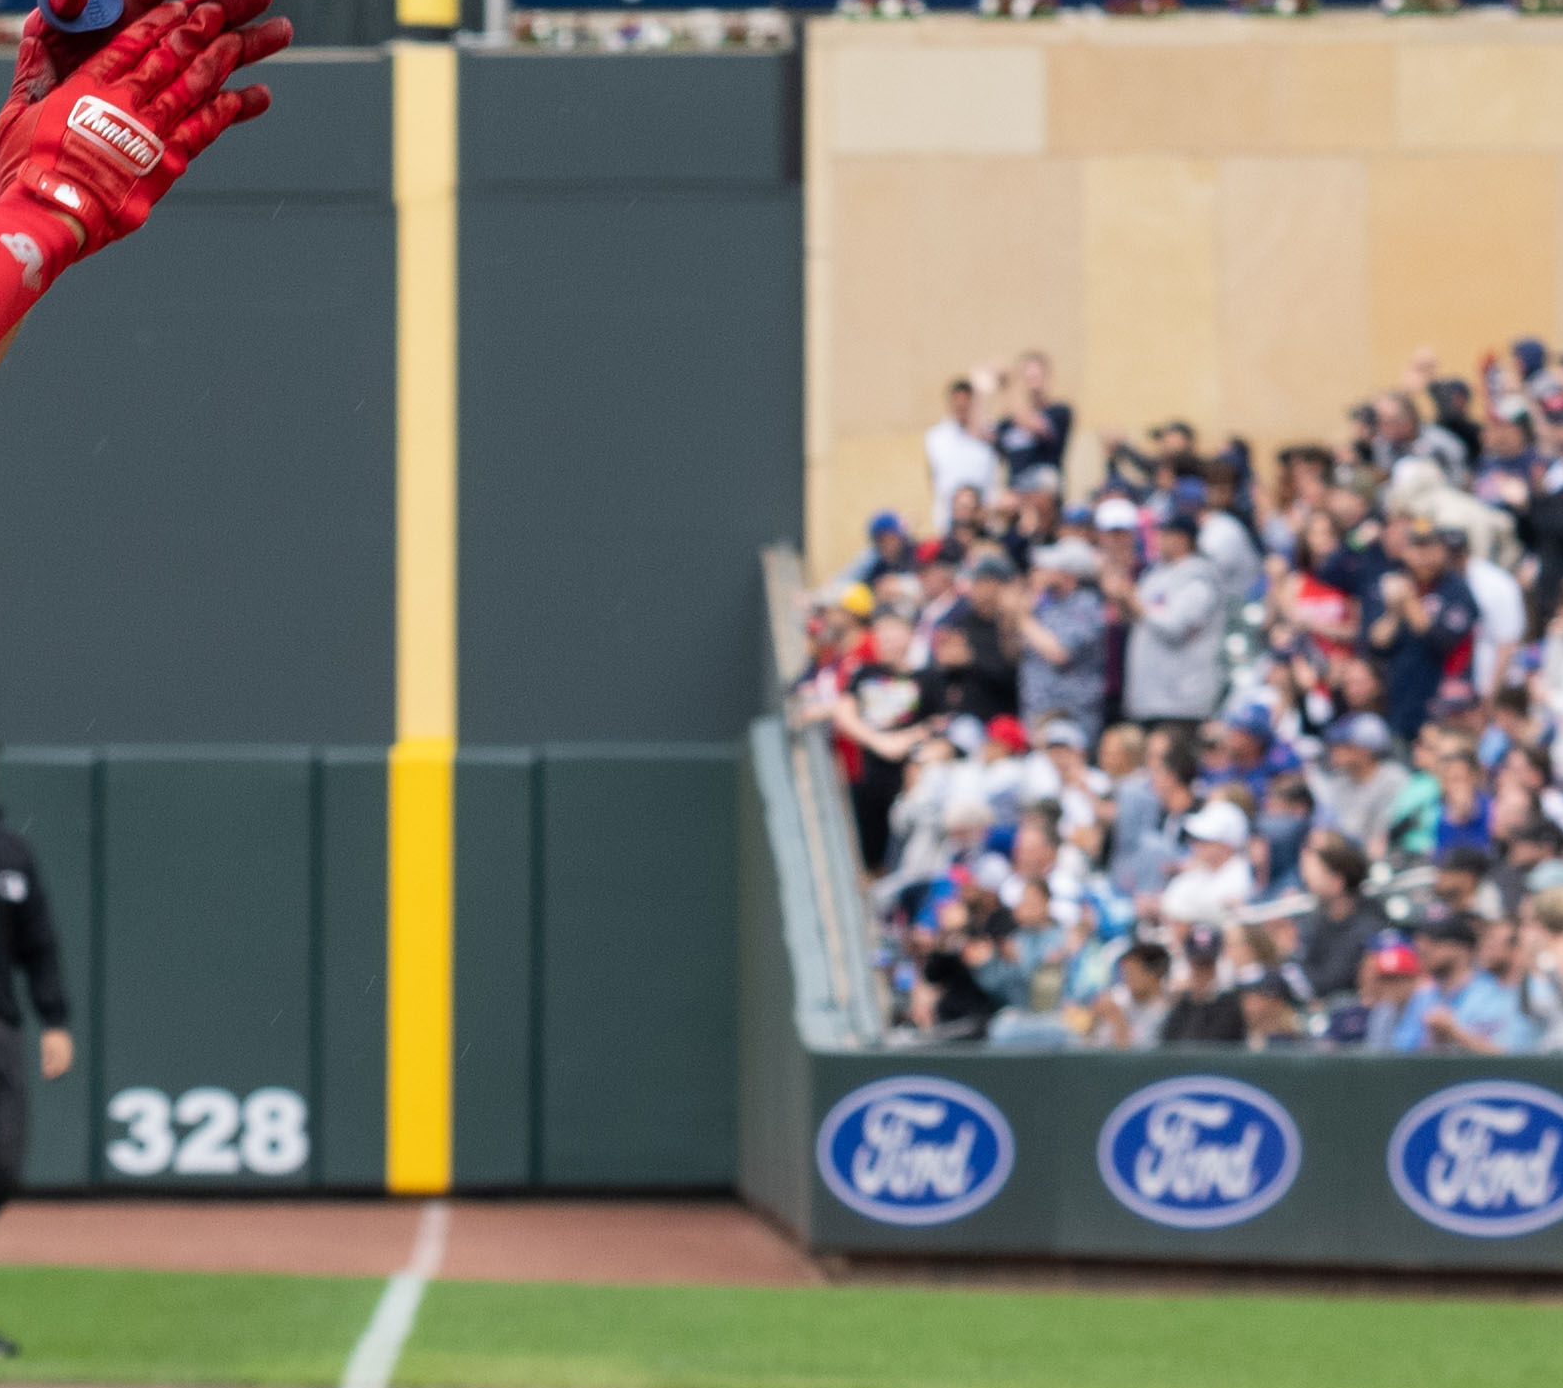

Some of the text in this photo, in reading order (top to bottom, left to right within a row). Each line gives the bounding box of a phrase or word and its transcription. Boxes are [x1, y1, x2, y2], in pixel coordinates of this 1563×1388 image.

[106, 1085, 310, 1176] 328
[851, 1095, 976, 1199] Ford
[1133, 1096, 1265, 1201] Ford
[1426, 1098, 1560, 1211] Ford
